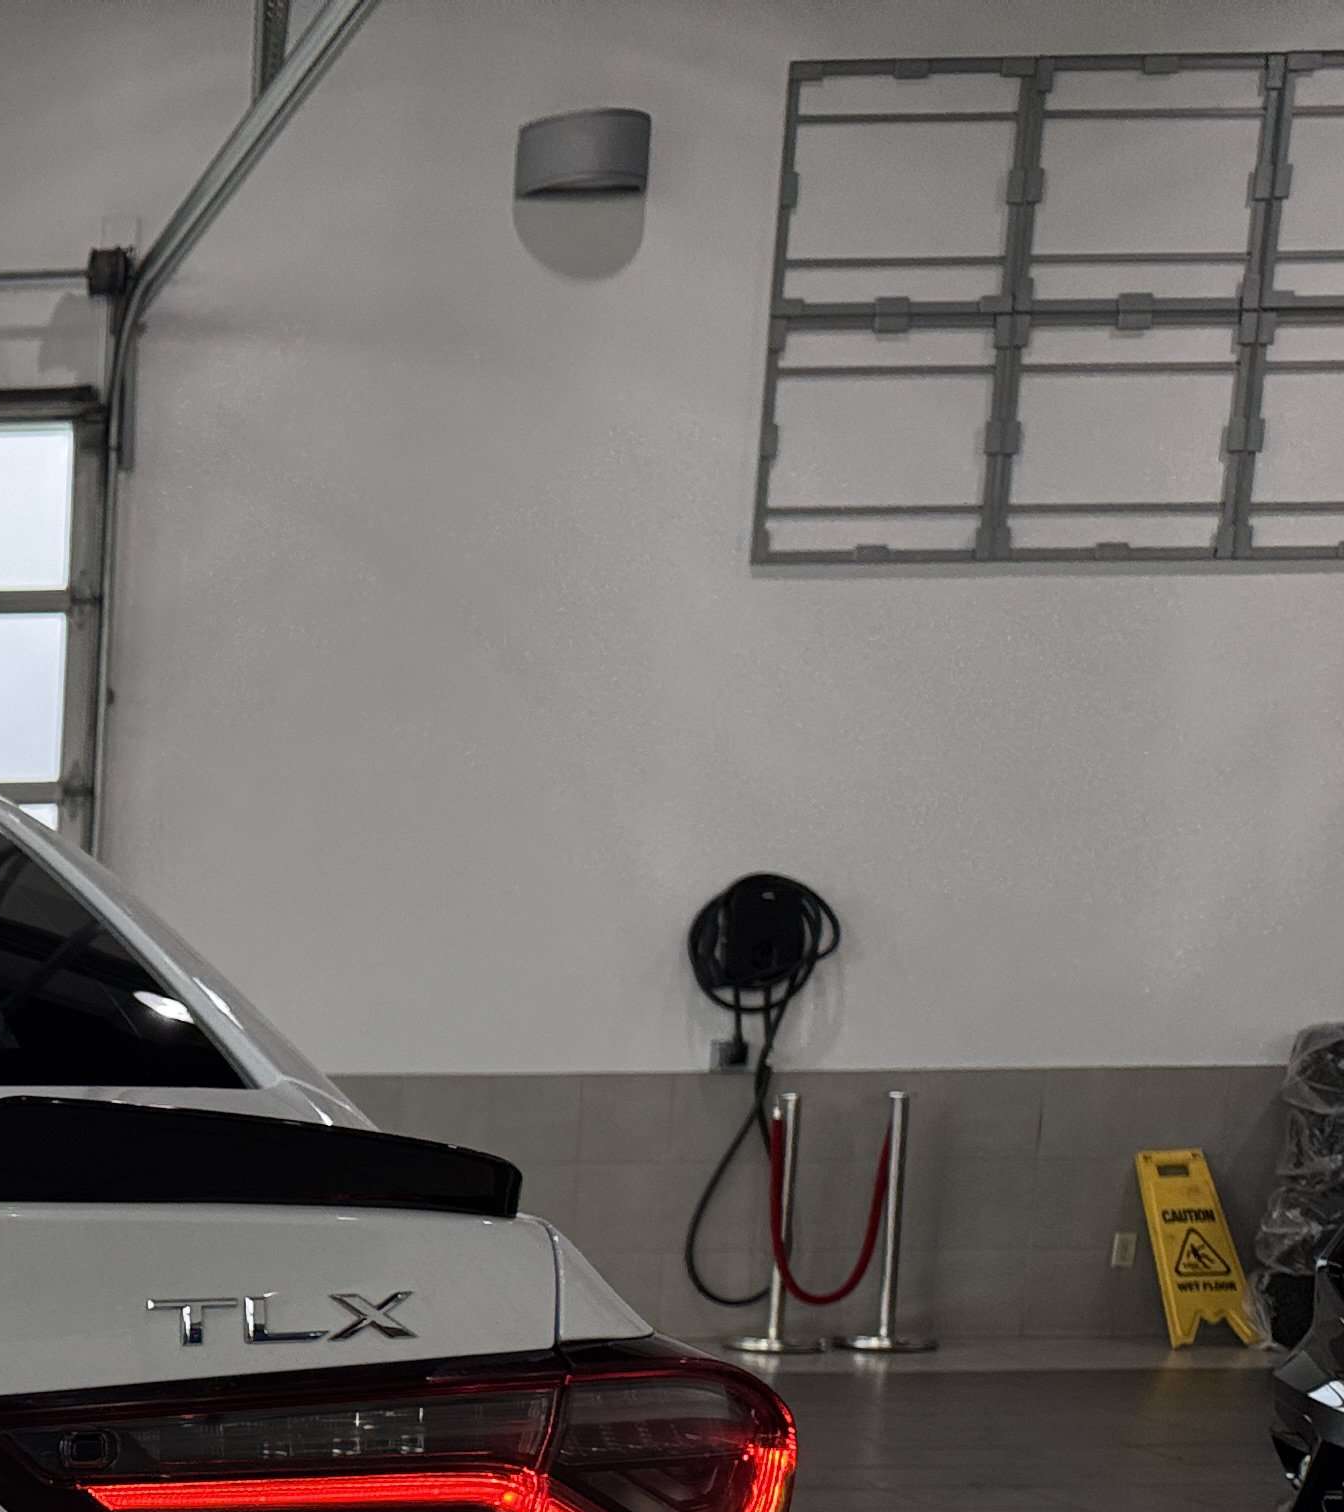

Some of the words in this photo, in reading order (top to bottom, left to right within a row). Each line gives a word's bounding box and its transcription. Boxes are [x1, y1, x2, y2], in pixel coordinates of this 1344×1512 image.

[1161, 1207, 1217, 1224] CAUTION
[1177, 1281, 1200, 1294] WET
[1202, 1281, 1238, 1293] FLOOR
[145, 1290, 418, 1346] TLX
